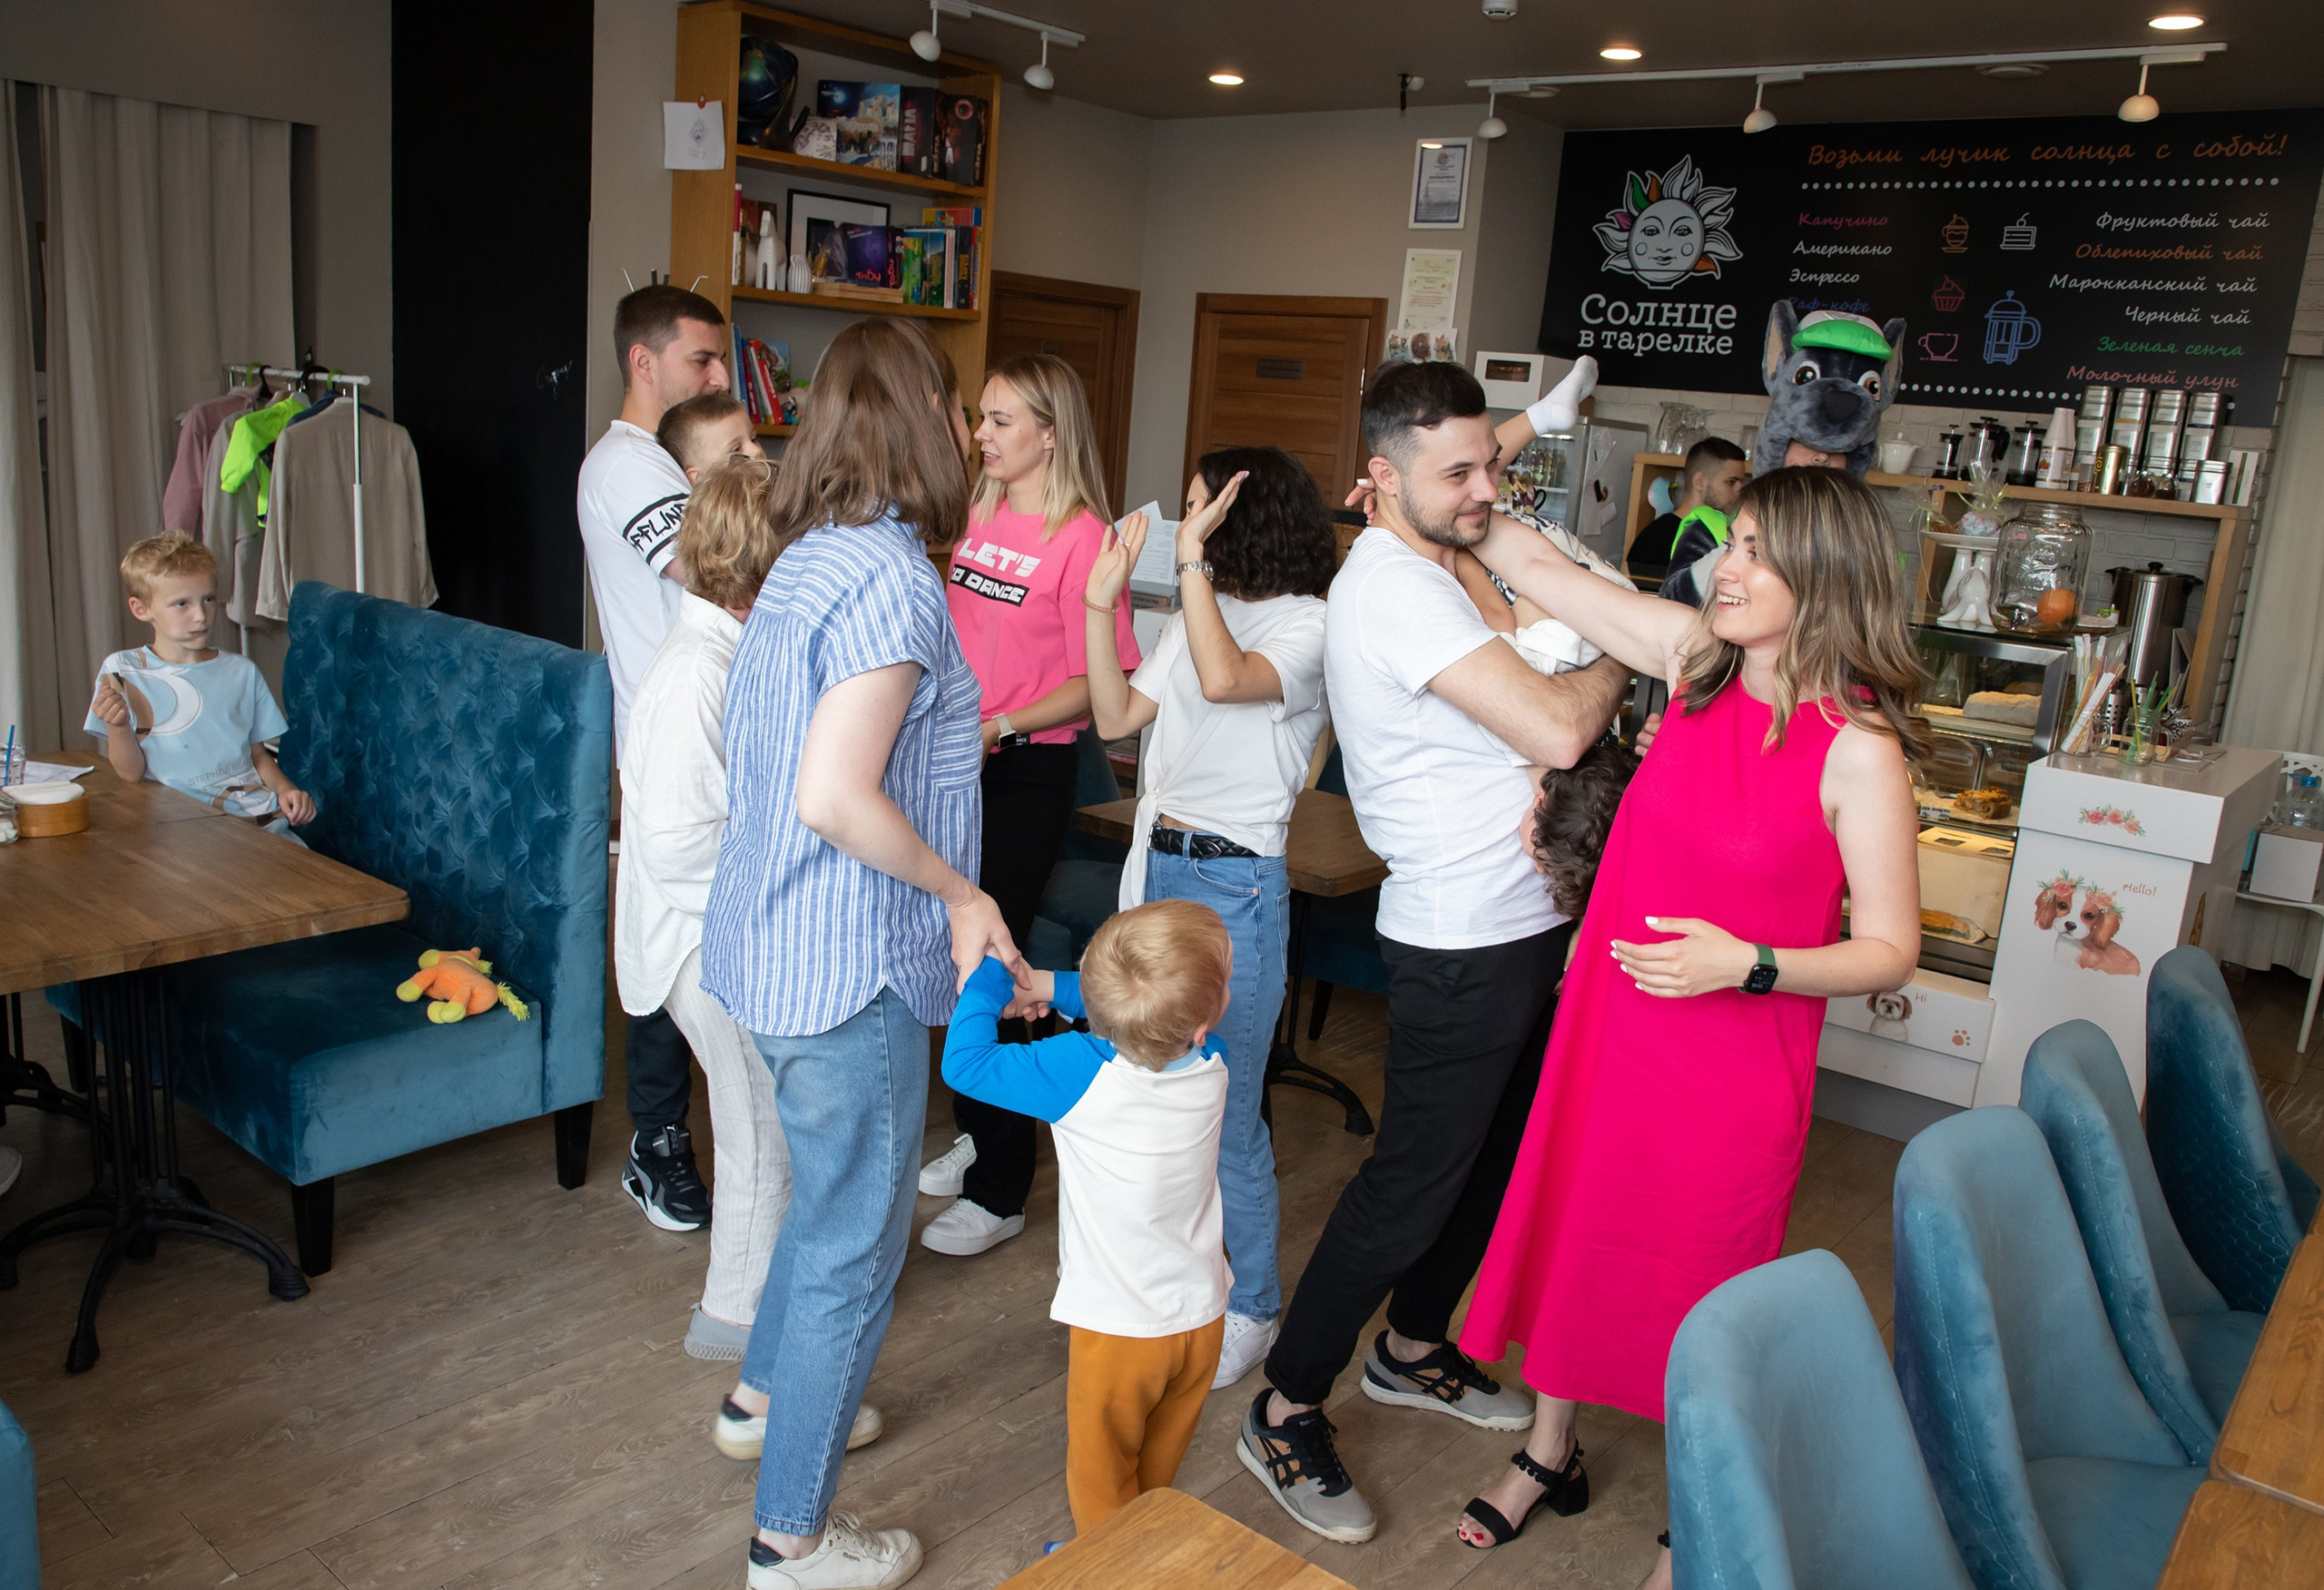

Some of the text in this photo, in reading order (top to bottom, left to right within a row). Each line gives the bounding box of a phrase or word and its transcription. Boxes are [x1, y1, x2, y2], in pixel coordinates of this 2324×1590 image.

[1807, 133, 2289, 169] Возьми лучик солнца с собой!
[1798, 211, 1888, 231] Капучино
[2095, 211, 2270, 231] Фруктовый чай
[1792, 240, 1893, 259] Американо
[2075, 243, 2264, 261] Облепиховый чай
[1788, 268, 1860, 286] Эспрессо
[2049, 273, 2258, 293] Марокканский чай
[1580, 293, 1738, 329] Солнце
[2125, 305, 2251, 326] Черный чай
[1578, 329, 1734, 357] в тарелке
[2097, 336, 2245, 357] Зеленая сенча
[2066, 365, 2240, 389] Молочный улун
[958, 537, 1041, 578] LET'S
[964, 572, 1026, 604] DANCE
[2122, 883, 2157, 898] Hello!
[1915, 992, 1928, 1003] Hi
